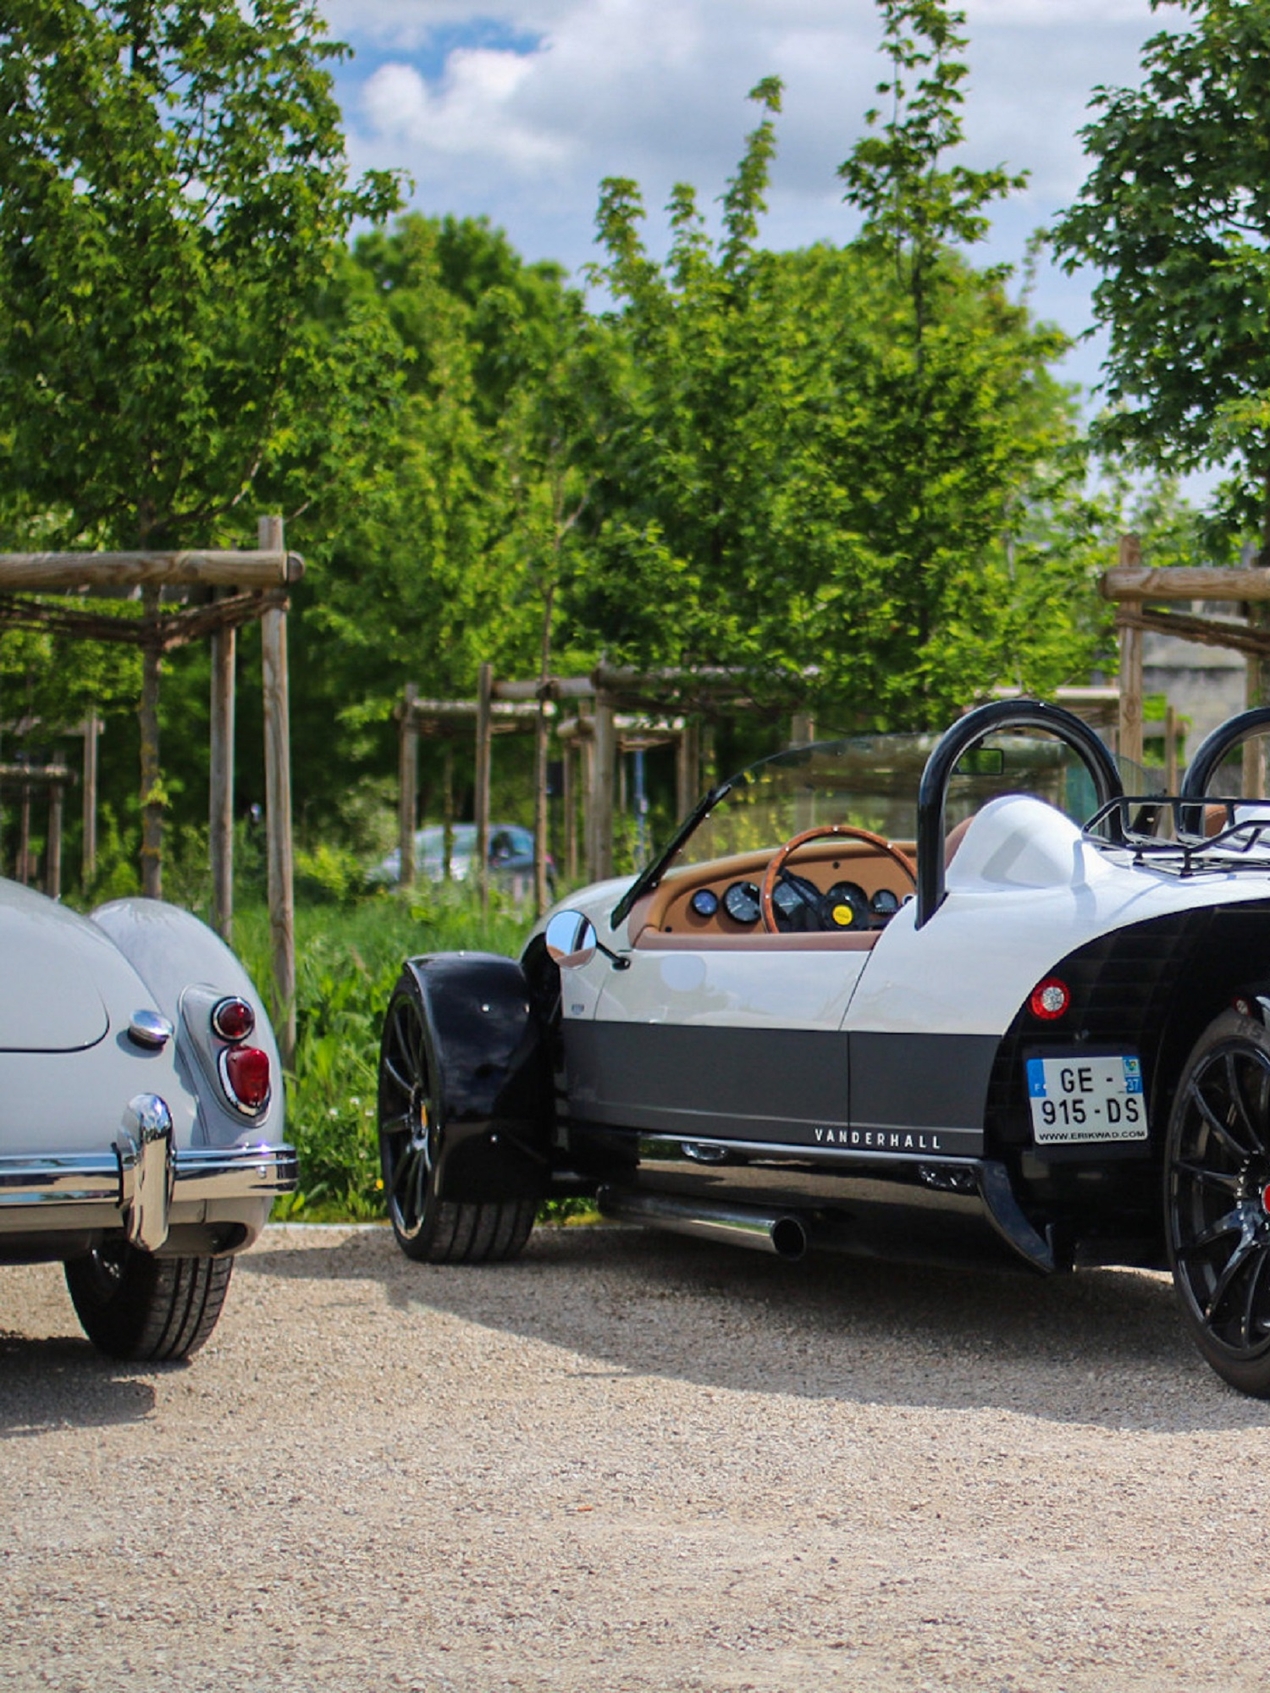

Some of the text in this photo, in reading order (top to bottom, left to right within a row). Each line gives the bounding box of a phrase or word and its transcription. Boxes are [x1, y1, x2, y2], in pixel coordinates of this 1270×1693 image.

[1034, 1083, 1041, 1092] F
[1126, 1078, 1140, 1091] 37
[814, 1128, 941, 1149] VANDERHALL
[1039, 1131, 1145, 1140] WWW.ERIKWAD.COM
